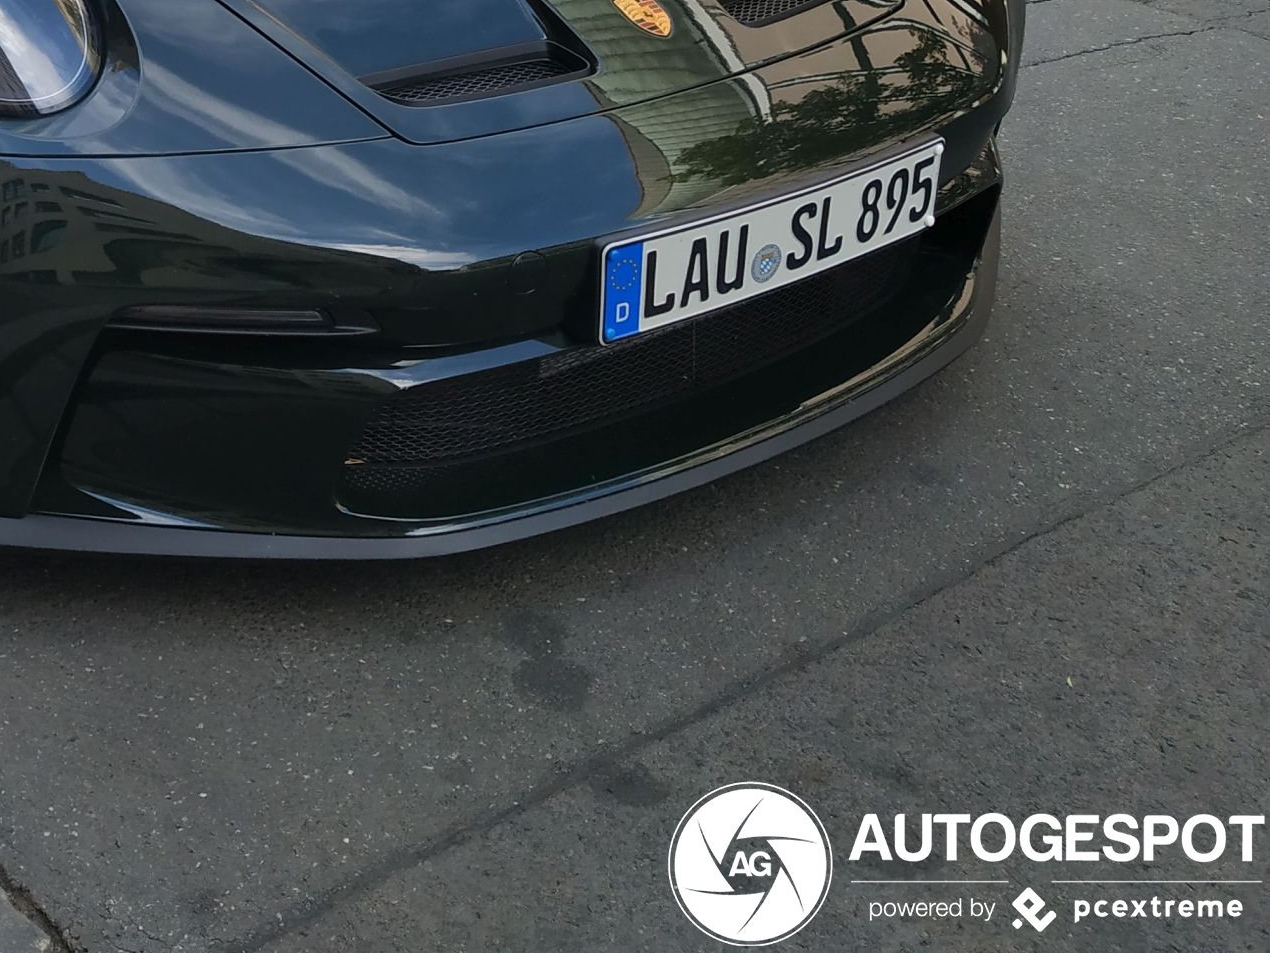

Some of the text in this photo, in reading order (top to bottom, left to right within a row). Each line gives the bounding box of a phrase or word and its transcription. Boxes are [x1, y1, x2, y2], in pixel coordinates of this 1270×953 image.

[644, 156, 935, 318] LAU SL 895
[615, 302, 629, 323] D
